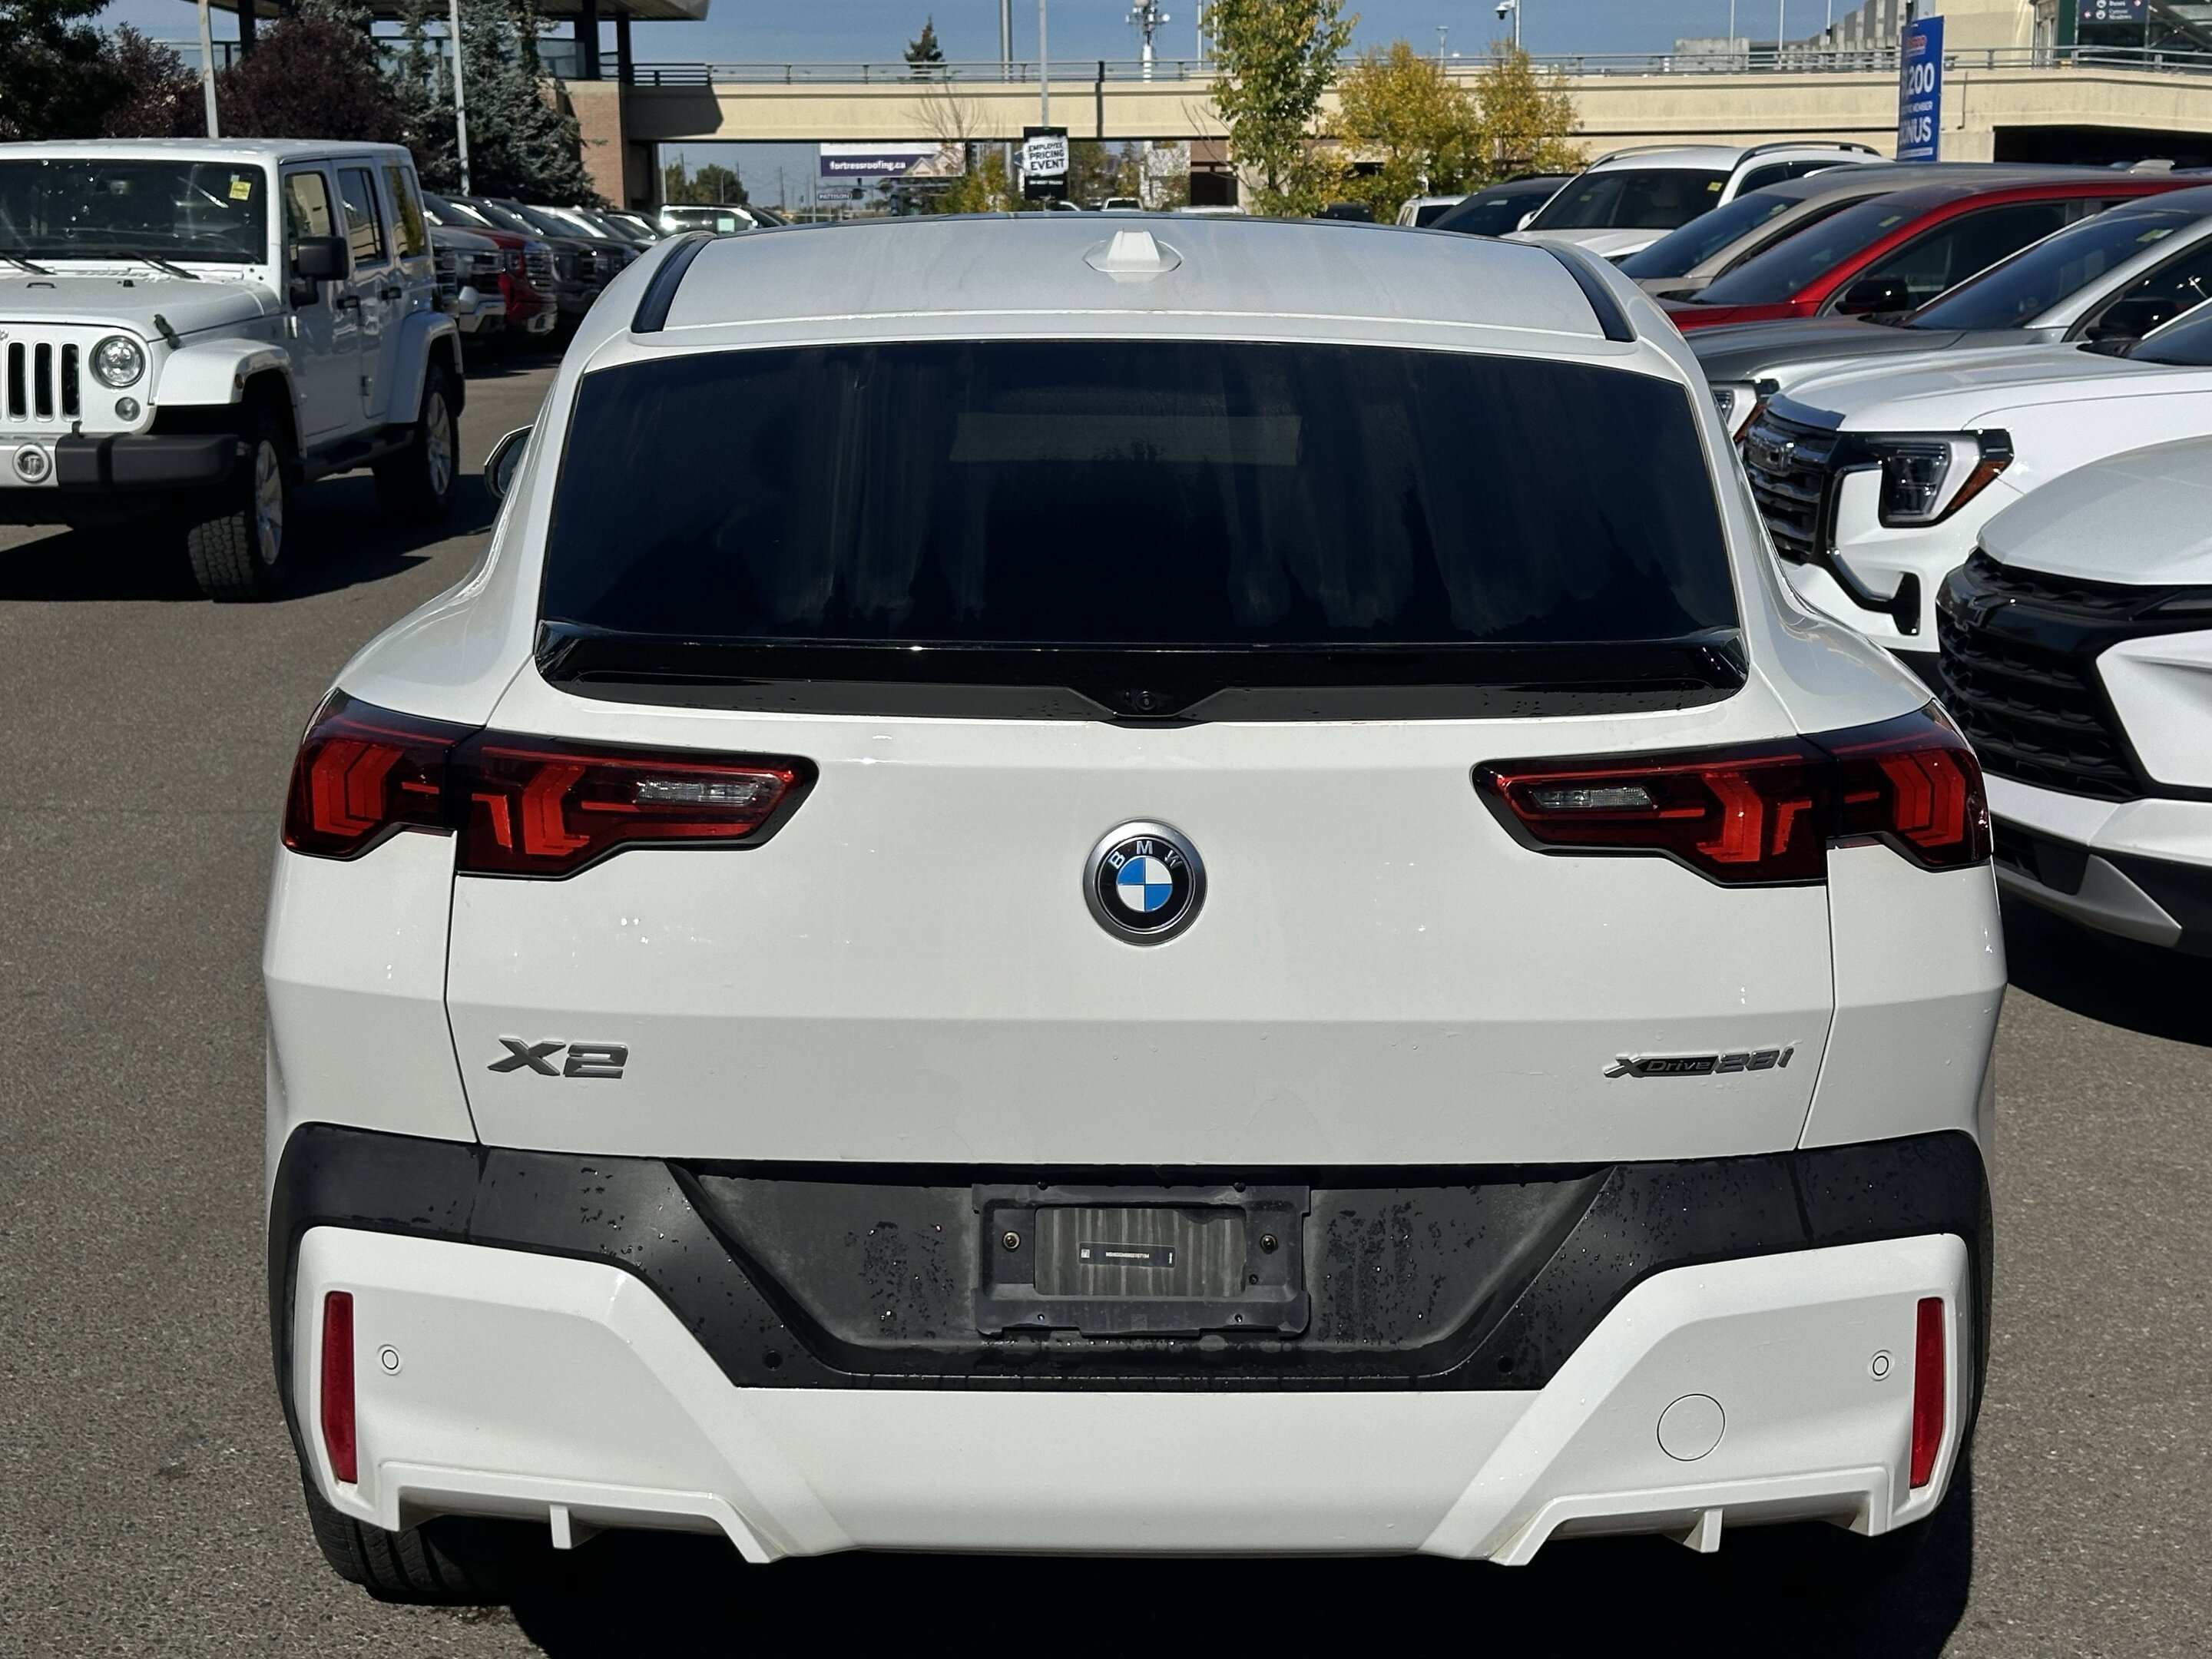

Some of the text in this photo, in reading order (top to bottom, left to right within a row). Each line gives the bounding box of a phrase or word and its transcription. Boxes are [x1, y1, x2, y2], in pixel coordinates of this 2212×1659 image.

[1028, 142, 1064, 152] EMPLOYEE
[1029, 150, 1065, 161] PRICING
[830, 160, 906, 171] fortressroofing.ca
[1031, 158, 1065, 171] EVENT
[1108, 840, 1184, 869] BMW
[486, 1037, 628, 1079] X2
